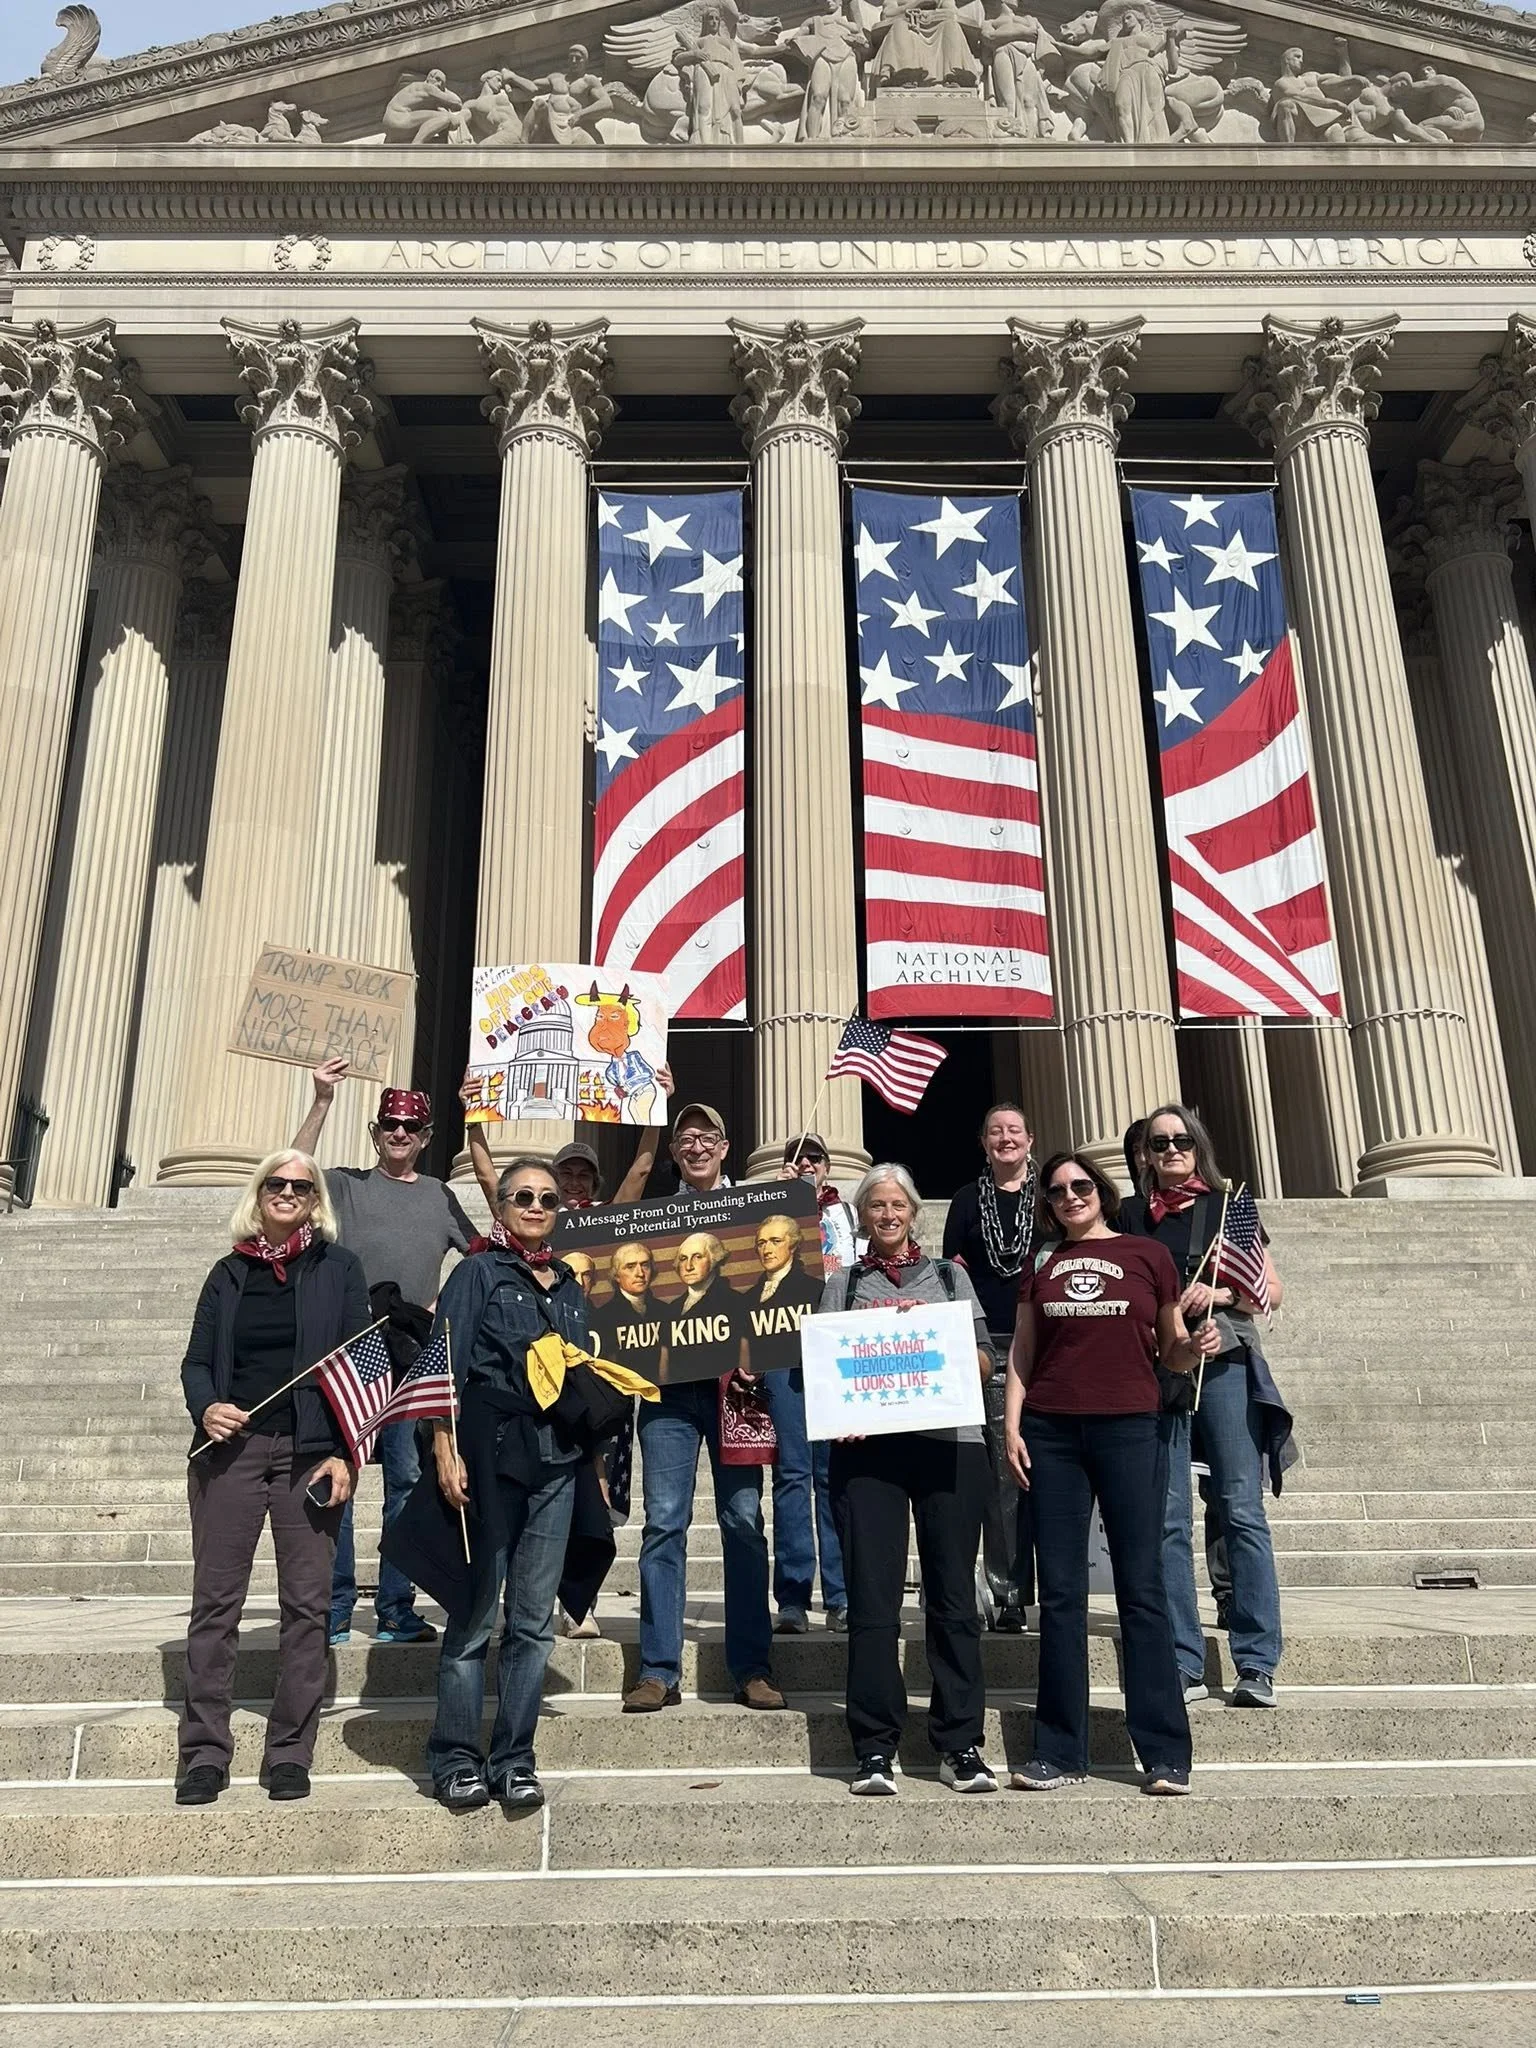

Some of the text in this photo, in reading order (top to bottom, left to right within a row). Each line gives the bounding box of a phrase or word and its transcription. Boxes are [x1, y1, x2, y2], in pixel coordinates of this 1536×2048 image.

[382, 238, 1479, 269] ARCHIVES OF THE UNITED STATES OF AMERICA
[896, 950, 1021, 966] NATIONAL
[263, 950, 397, 1000] TRUMP SUCK
[485, 964, 546, 1010] HANDS
[492, 966, 516, 985] LITTLE
[896, 968, 1022, 983] ARCHIVES
[246, 987, 397, 1044] MORE THAN
[479, 1001, 512, 1034] OFF
[565, 1188, 788, 1230] A Message From Our Founding Fathers
[614, 1211, 732, 1237] to Potential Tyrants:
[1049, 1257, 1124, 1280] HARVARD
[1042, 1300, 1130, 1317] UNIVERSITY
[616, 1321, 661, 1350] FAUX
[671, 1314, 730, 1347] KING
[852, 1339, 926, 1359] THIS IS WHAT
[853, 1353, 927, 1375] DEMOCRACY
[854, 1370, 930, 1392] LOOKS LIKE
